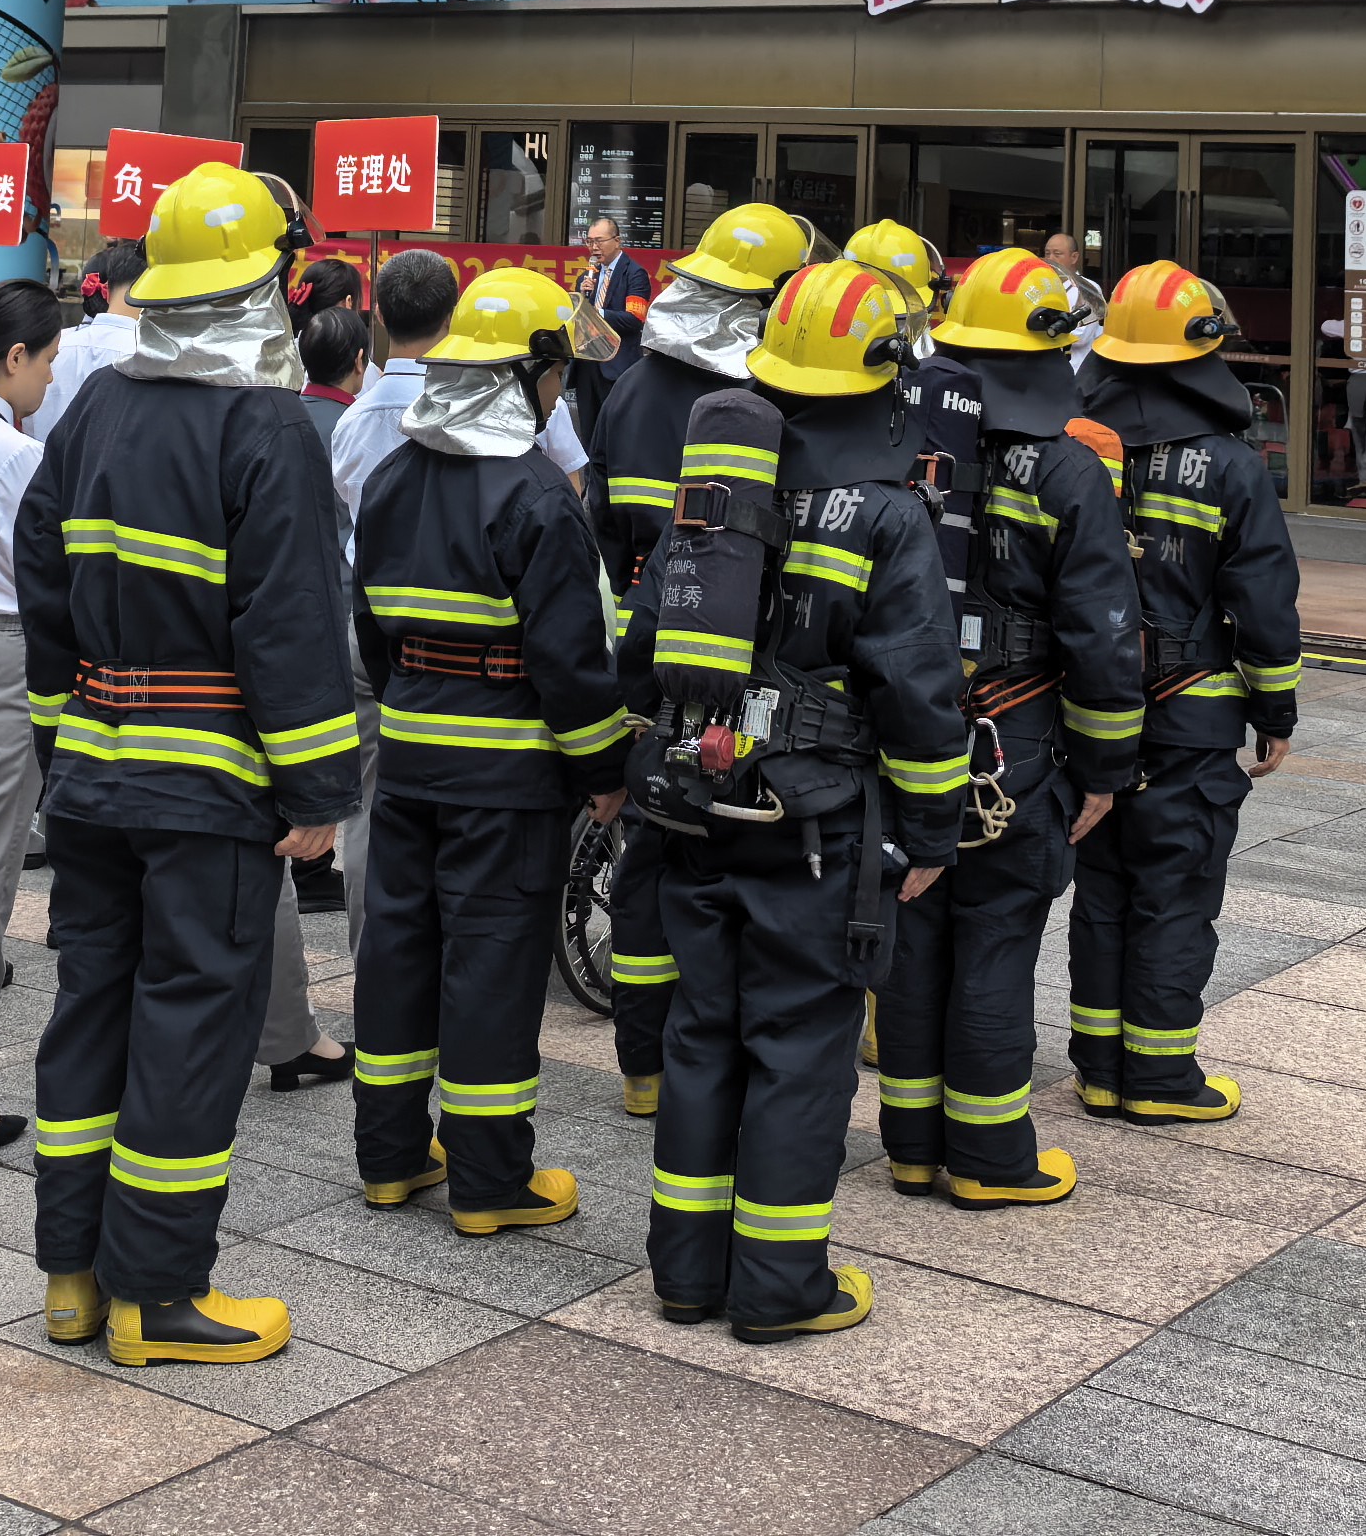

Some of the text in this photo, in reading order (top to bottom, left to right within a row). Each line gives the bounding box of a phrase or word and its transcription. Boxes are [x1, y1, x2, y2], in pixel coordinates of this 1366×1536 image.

[580, 145, 595, 154] L10
[335, 152, 412, 197] 管理处
[580, 167, 591, 177] L9
[661, 584, 703, 609] 越秀
